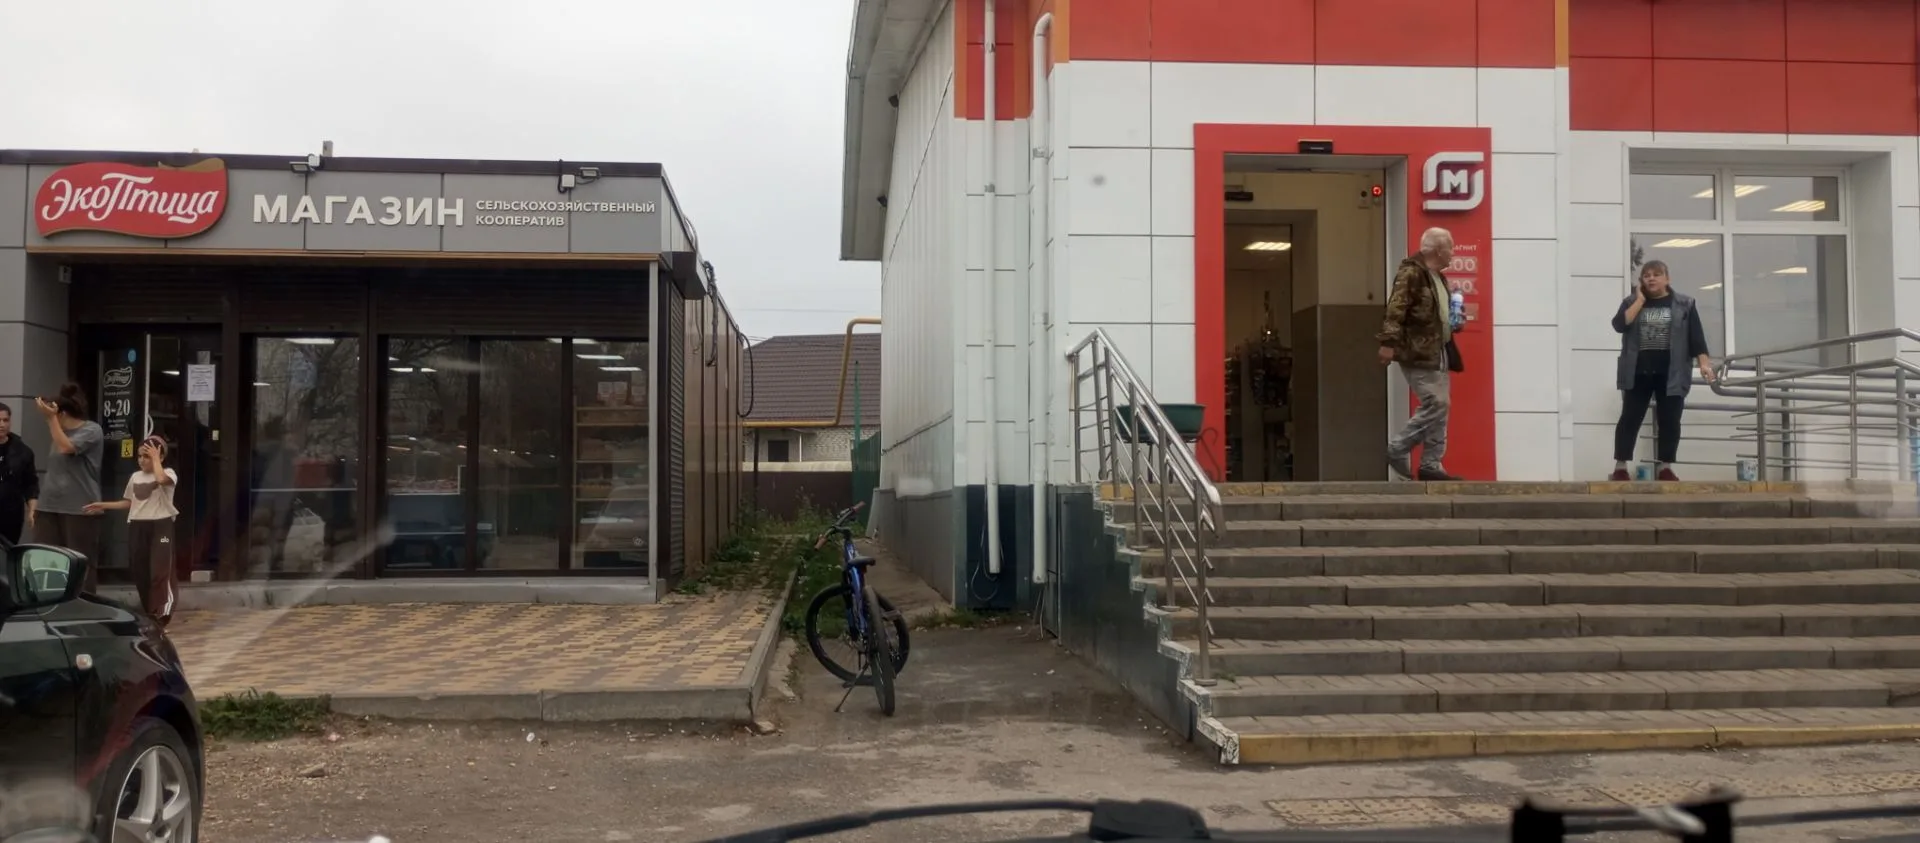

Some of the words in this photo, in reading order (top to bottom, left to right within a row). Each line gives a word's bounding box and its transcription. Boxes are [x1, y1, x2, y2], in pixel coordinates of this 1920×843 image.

[42, 172, 219, 224] ЭкоПтица
[253, 194, 464, 226] МАГАЗИН
[475, 200, 656, 213] СЕЛЬСКОХОЗЯЙСТВЕННЫЙ
[475, 215, 565, 227] КООПЕРАТИВ
[1453, 244, 1477, 252] АГНИТ
[103, 398, 131, 417] 8-20
